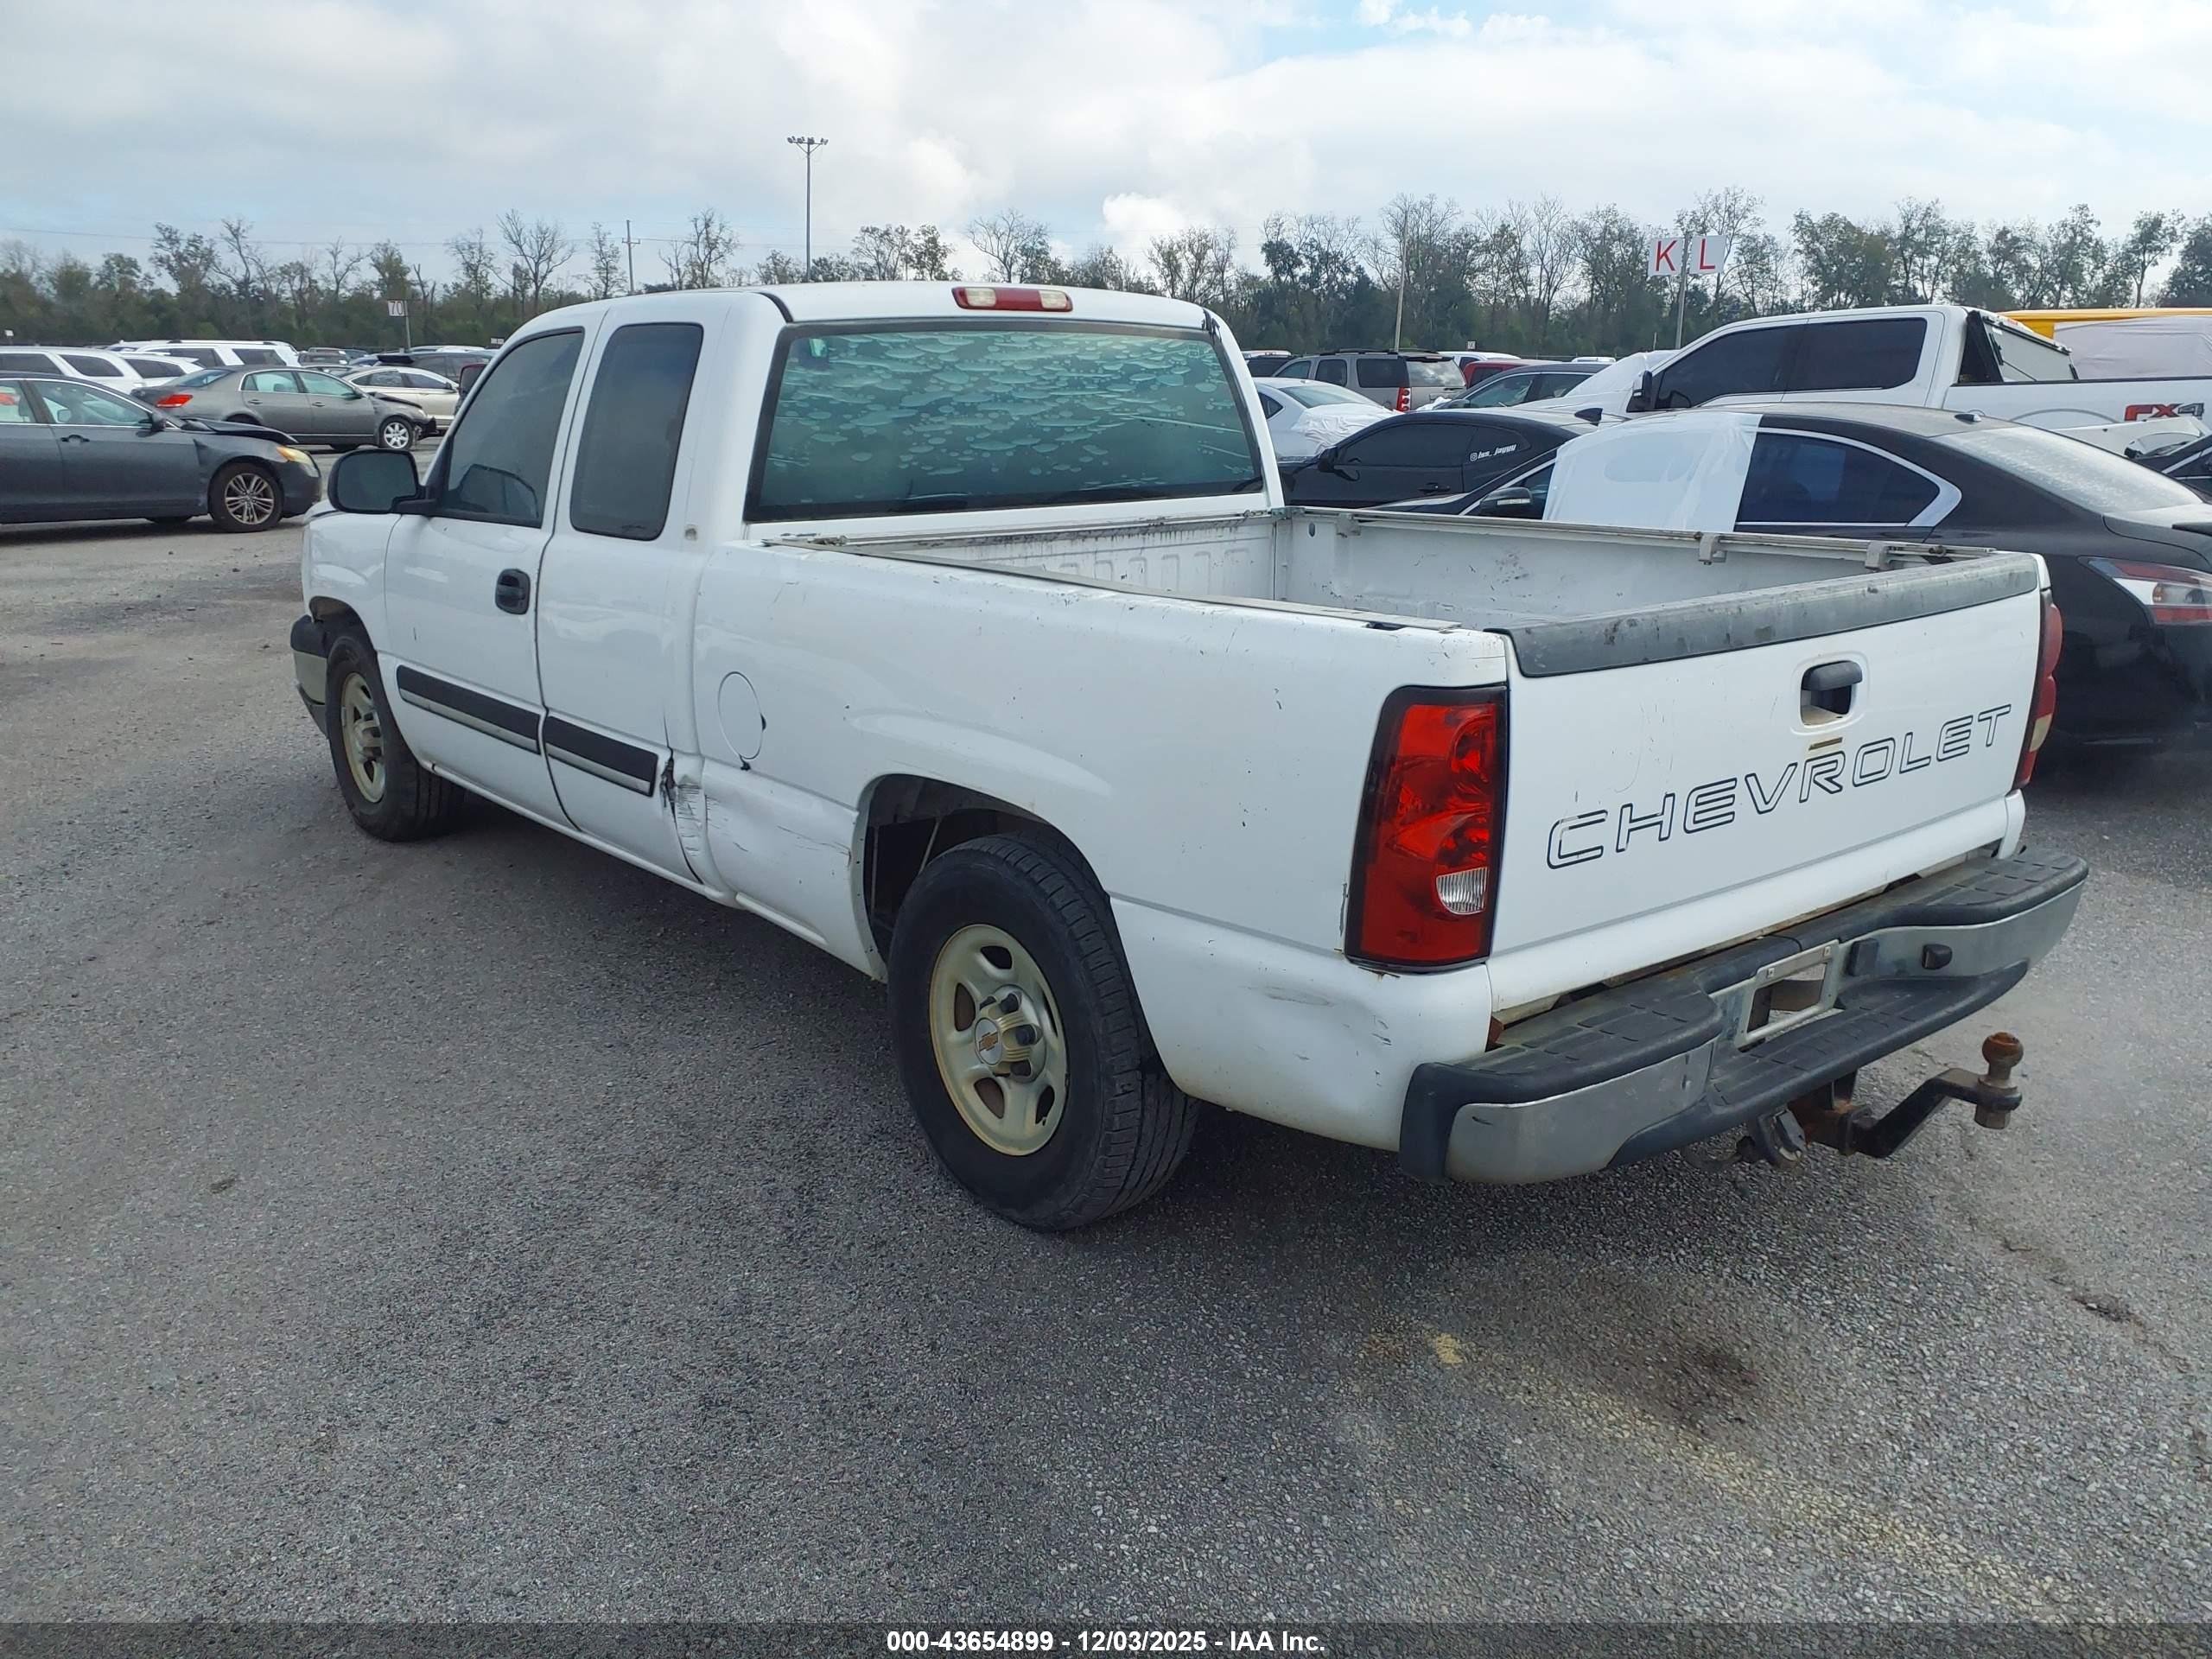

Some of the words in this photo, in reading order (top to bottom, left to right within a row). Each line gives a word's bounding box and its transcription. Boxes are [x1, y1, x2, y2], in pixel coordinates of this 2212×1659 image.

[1656, 240, 1677, 271] K
[1700, 238, 1715, 270] L
[391, 301, 404, 315] 70
[2125, 403, 2204, 421] FX4
[1547, 704, 2012, 869] CHEVROLET
